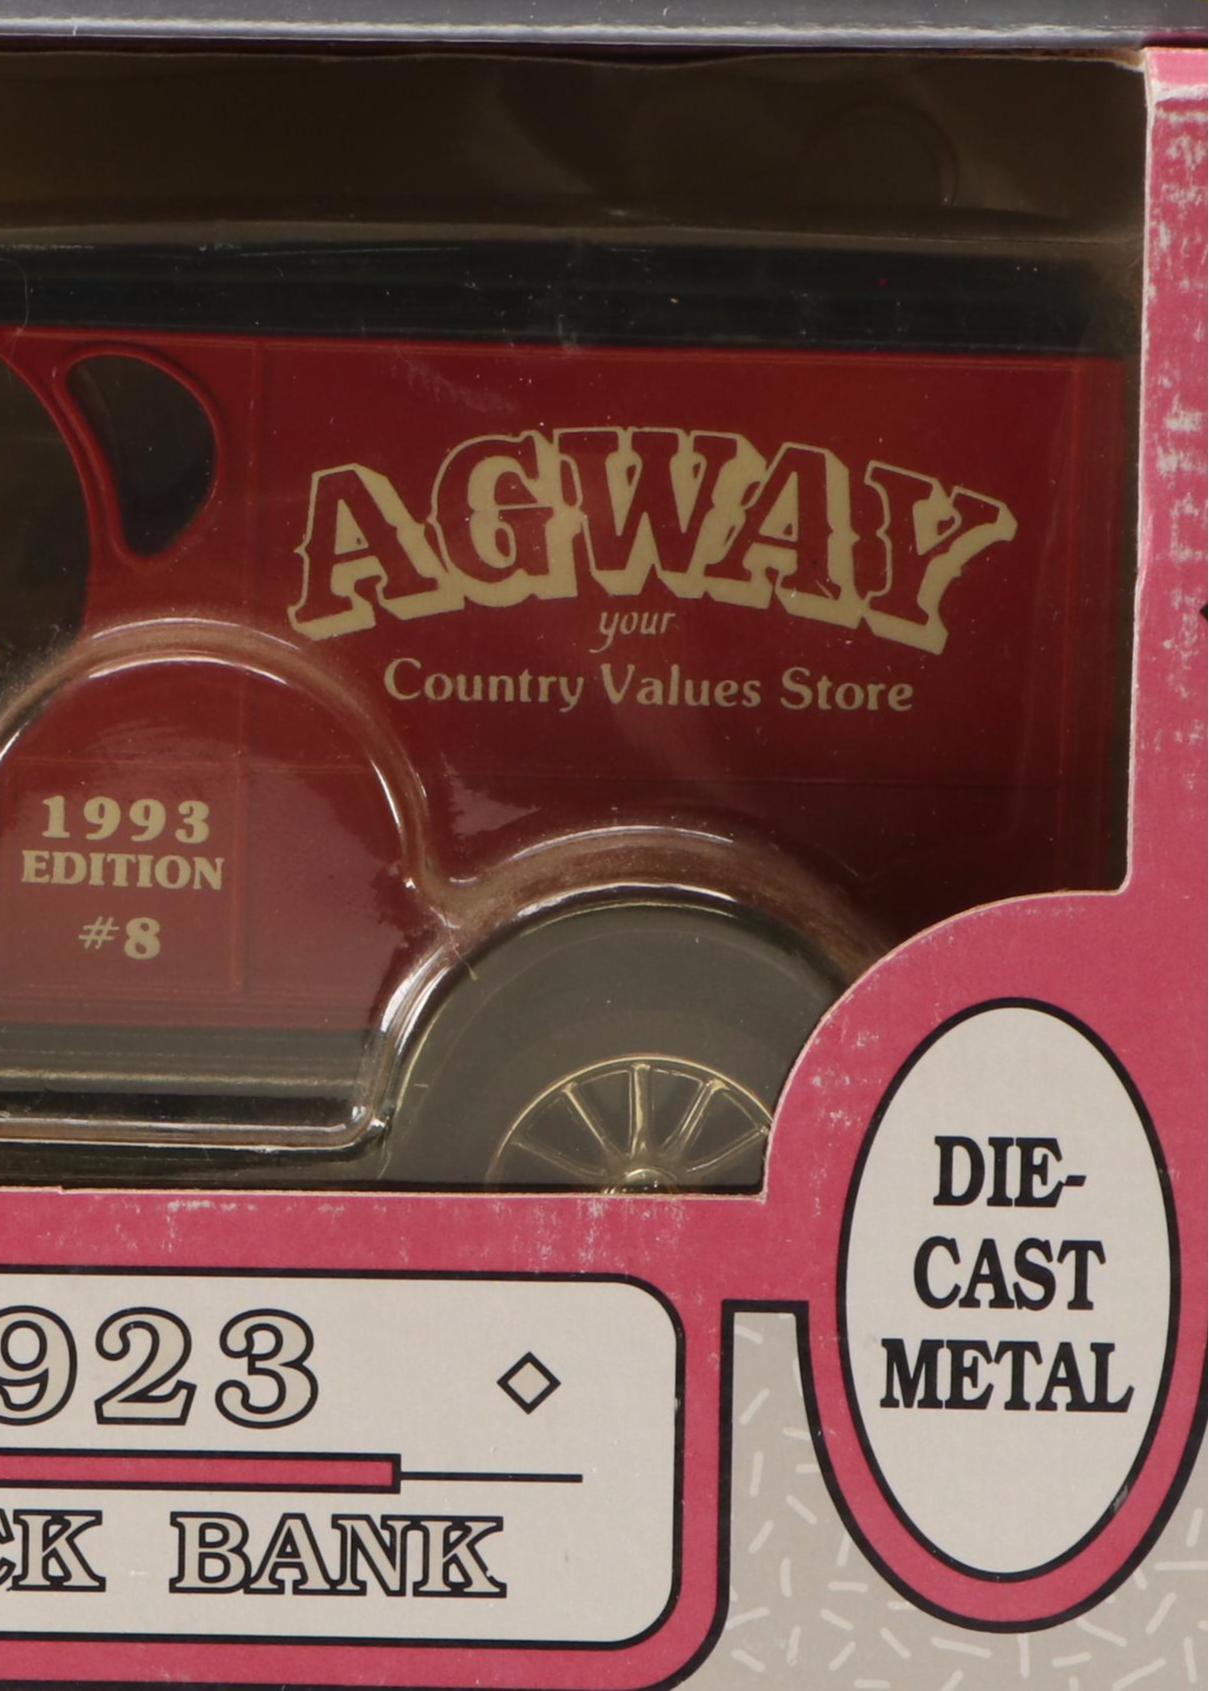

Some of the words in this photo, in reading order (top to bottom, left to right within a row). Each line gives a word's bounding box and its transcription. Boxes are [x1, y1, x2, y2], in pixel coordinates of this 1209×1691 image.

[287, 426, 1018, 655] AGWAY
[590, 610, 676, 653] your
[383, 657, 584, 713] Country
[601, 664, 761, 708] Values
[780, 666, 914, 711] Store
[42, 795, 210, 843] 1993
[21, 850, 225, 890] EDITION
[78, 916, 161, 960] #8
[933, 1136, 1086, 1207] DIE-
[914, 1236, 1106, 1311] CAST
[880, 1338, 1135, 1412] METAL
[169, 1511, 507, 1599] BANK
